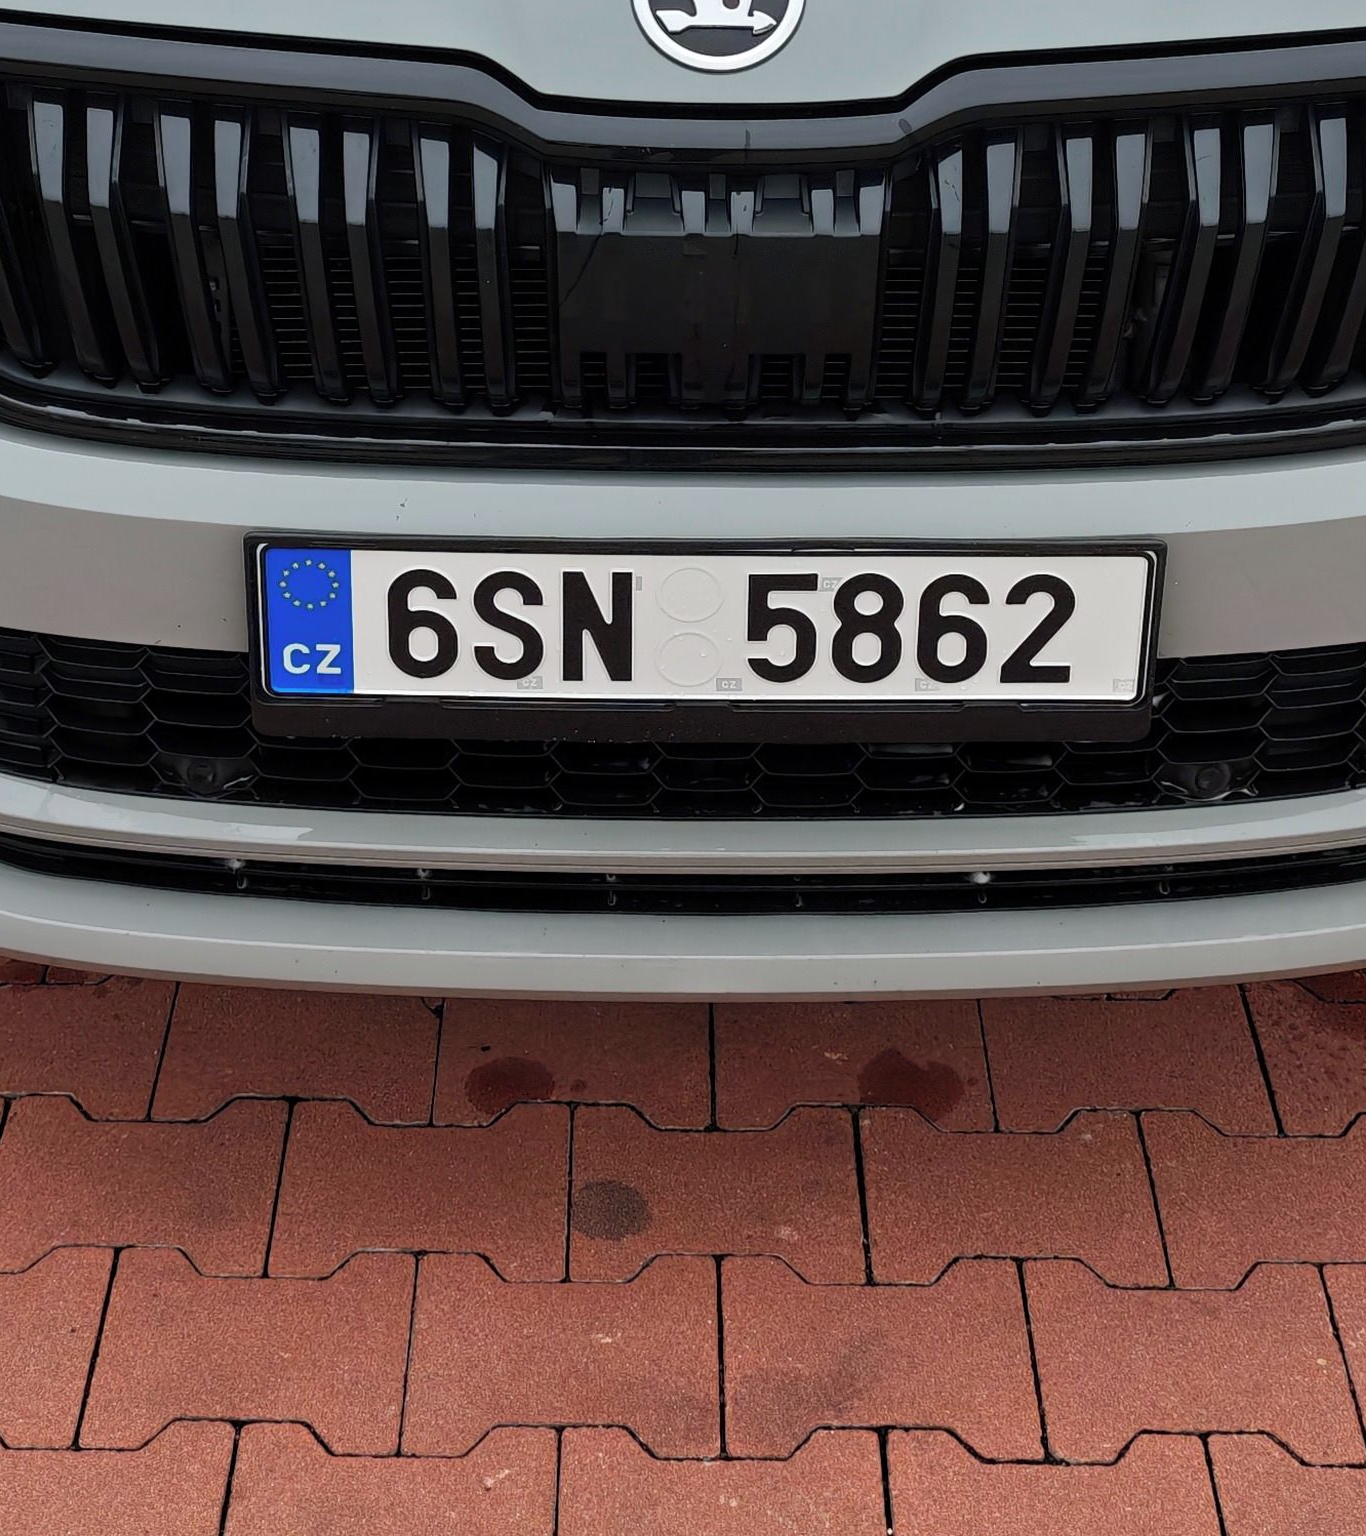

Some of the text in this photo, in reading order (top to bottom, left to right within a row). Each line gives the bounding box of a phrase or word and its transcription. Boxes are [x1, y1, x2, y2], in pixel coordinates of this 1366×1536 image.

[282, 642, 341, 675] CZ
[387, 568, 1076, 683] 6SN 5862
